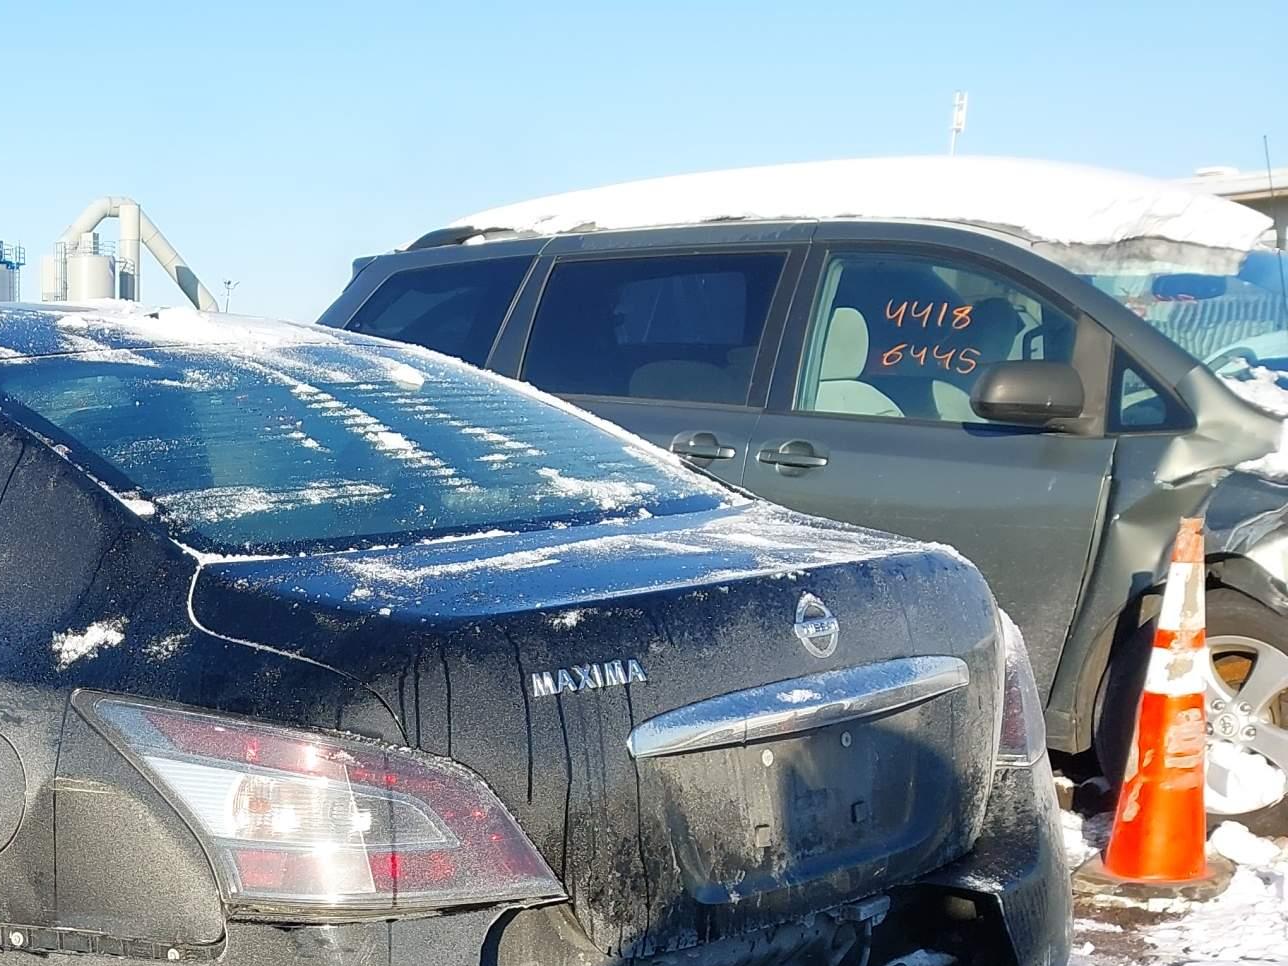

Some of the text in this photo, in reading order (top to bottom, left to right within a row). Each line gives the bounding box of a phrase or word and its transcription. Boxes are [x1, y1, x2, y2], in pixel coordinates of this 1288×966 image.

[885, 299, 973, 330] 4418
[882, 343, 982, 374] 6445
[532, 659, 647, 697] MAXIMA
